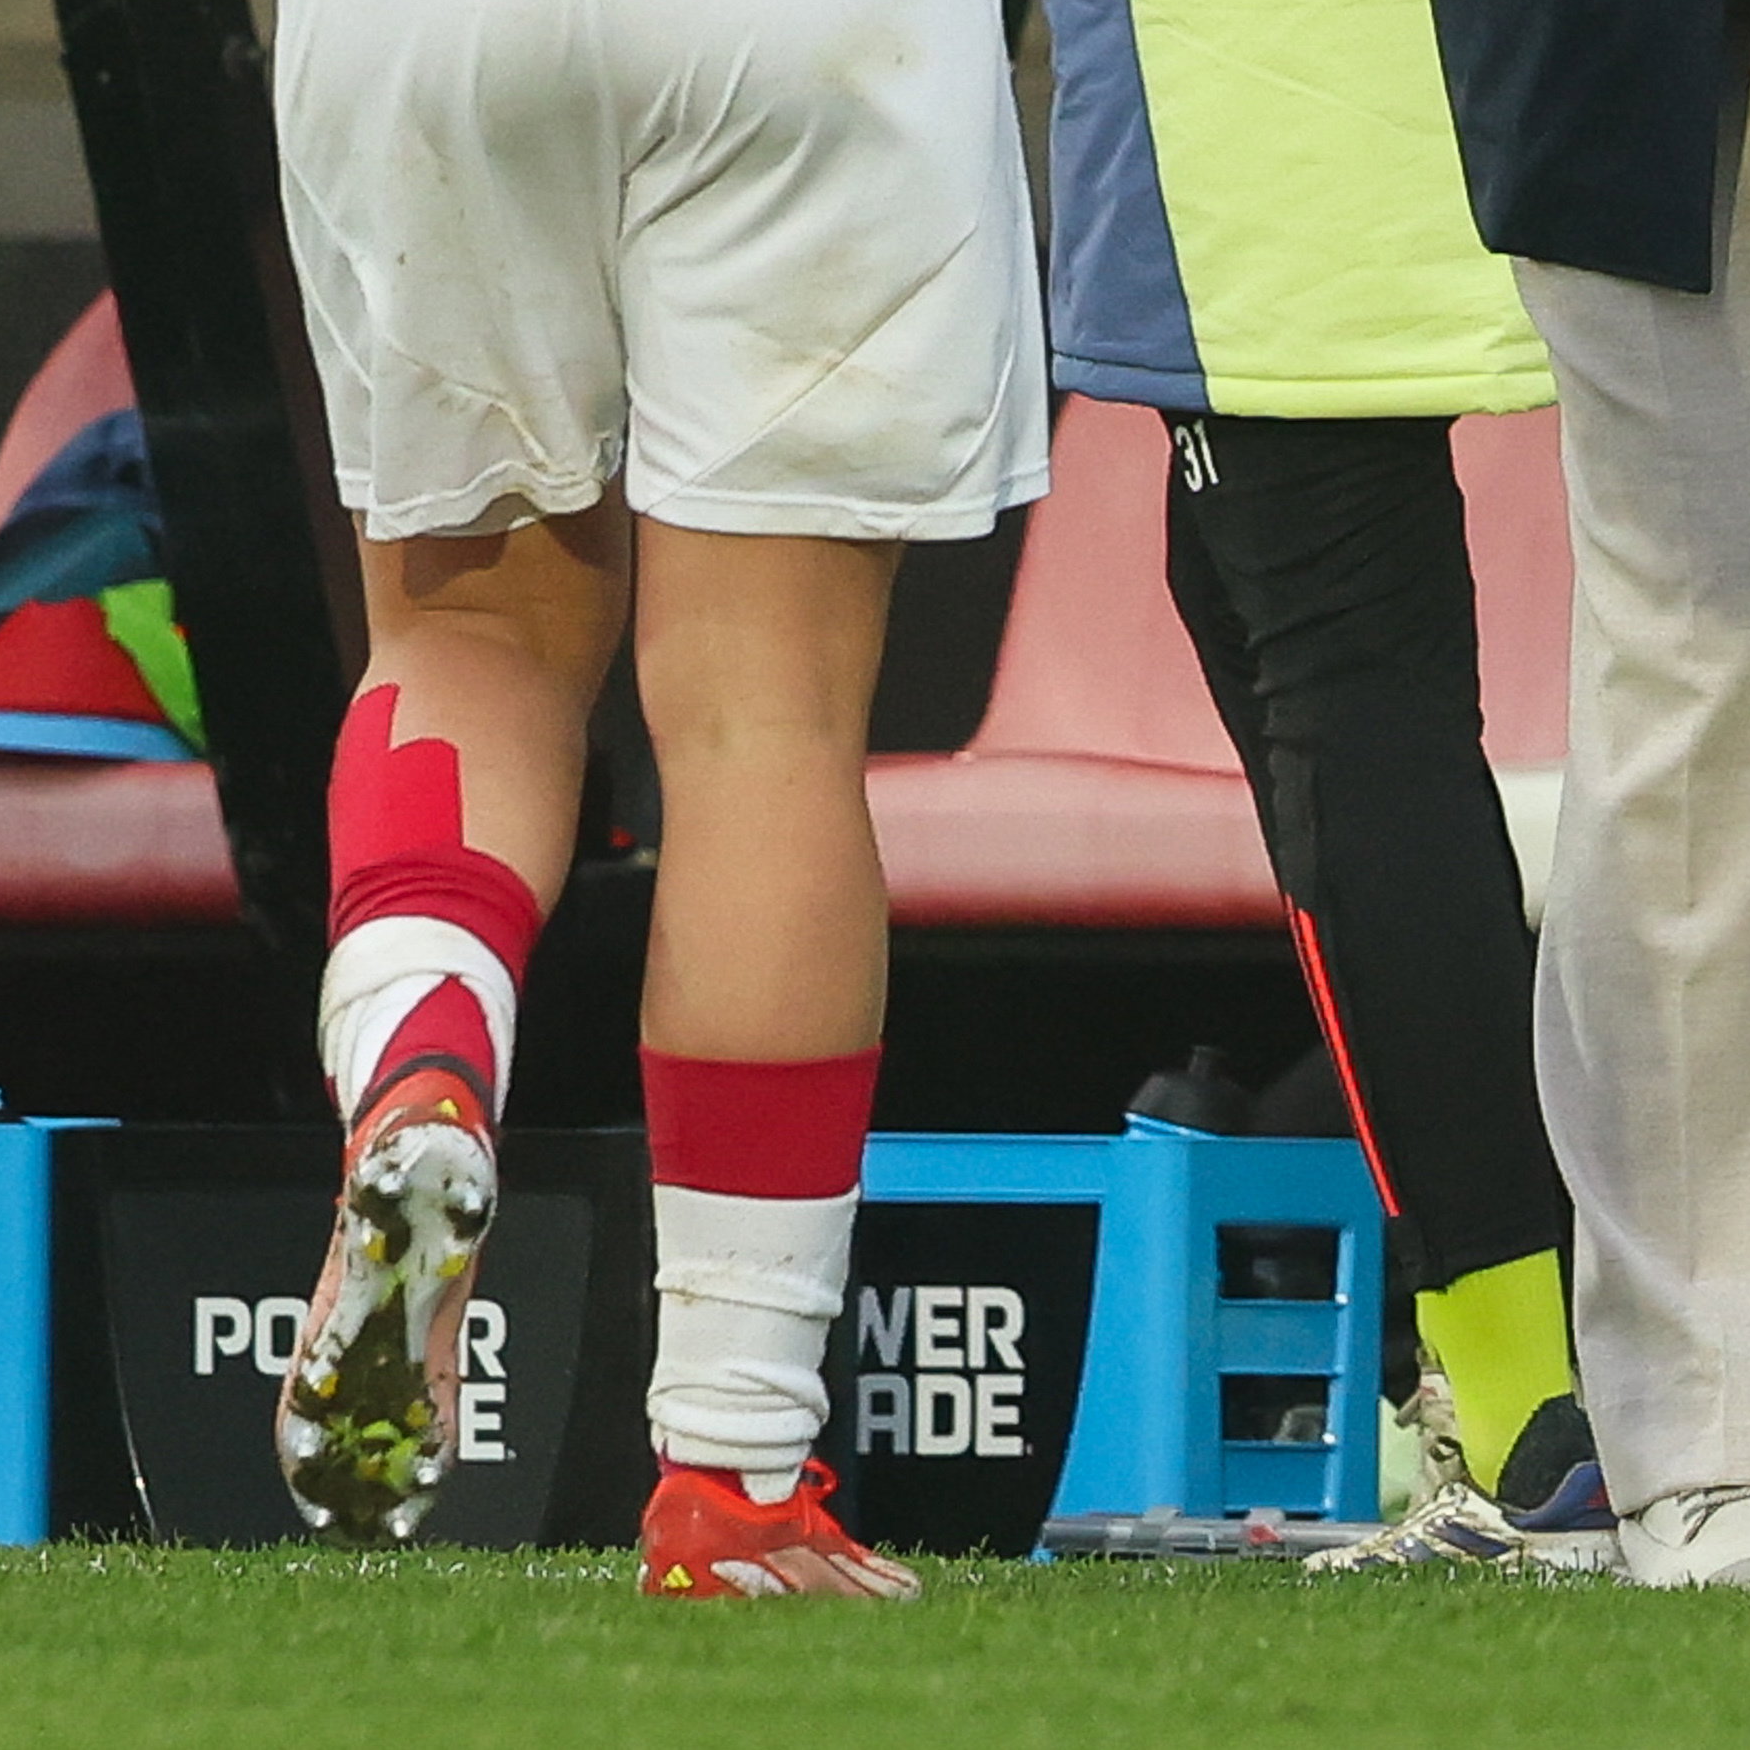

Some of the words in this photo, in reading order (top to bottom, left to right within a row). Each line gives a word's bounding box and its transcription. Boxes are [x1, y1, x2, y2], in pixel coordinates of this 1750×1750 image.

[1174, 418, 1220, 492] 31
[194, 1296, 507, 1378] POR
[857, 1285, 1025, 1369] WER
[856, 1373, 1024, 1456] ADE
